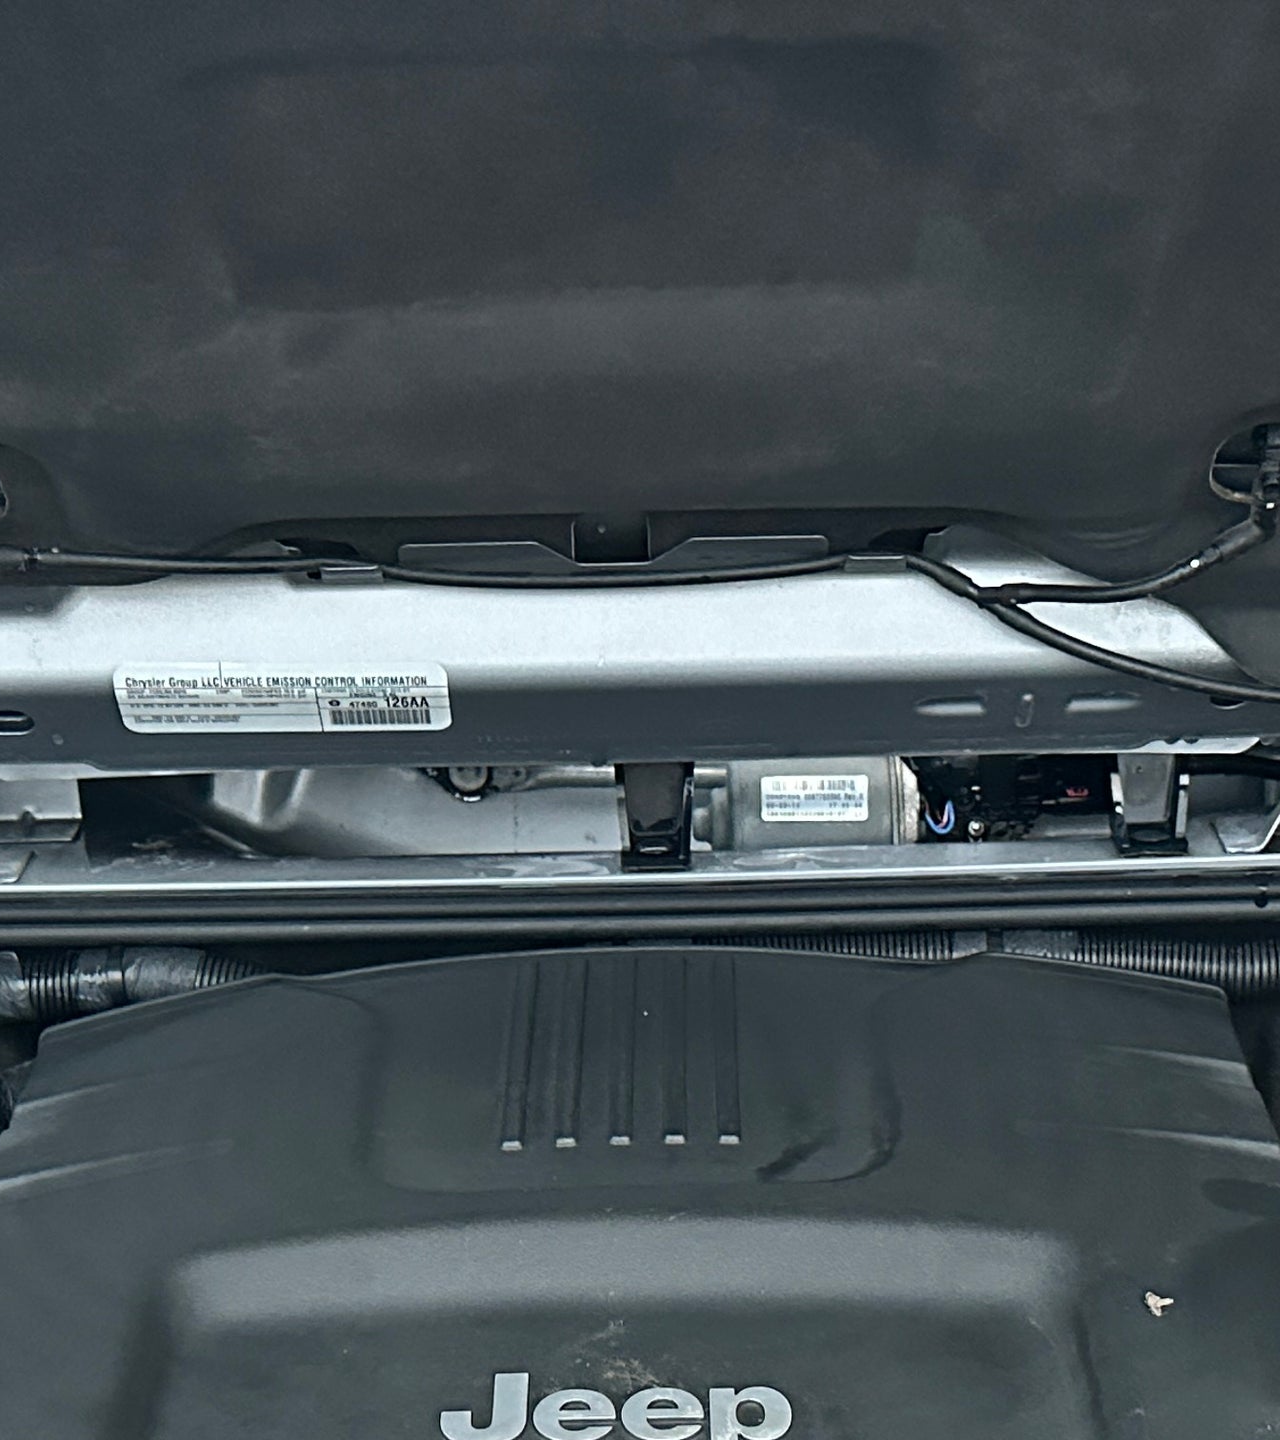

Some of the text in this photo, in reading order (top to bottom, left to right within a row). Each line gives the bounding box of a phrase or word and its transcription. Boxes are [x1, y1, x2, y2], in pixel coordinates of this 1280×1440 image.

[125, 676, 427, 689] Chrysler Group LLC VEHICLE EMISSION CONTROL INFORMATION
